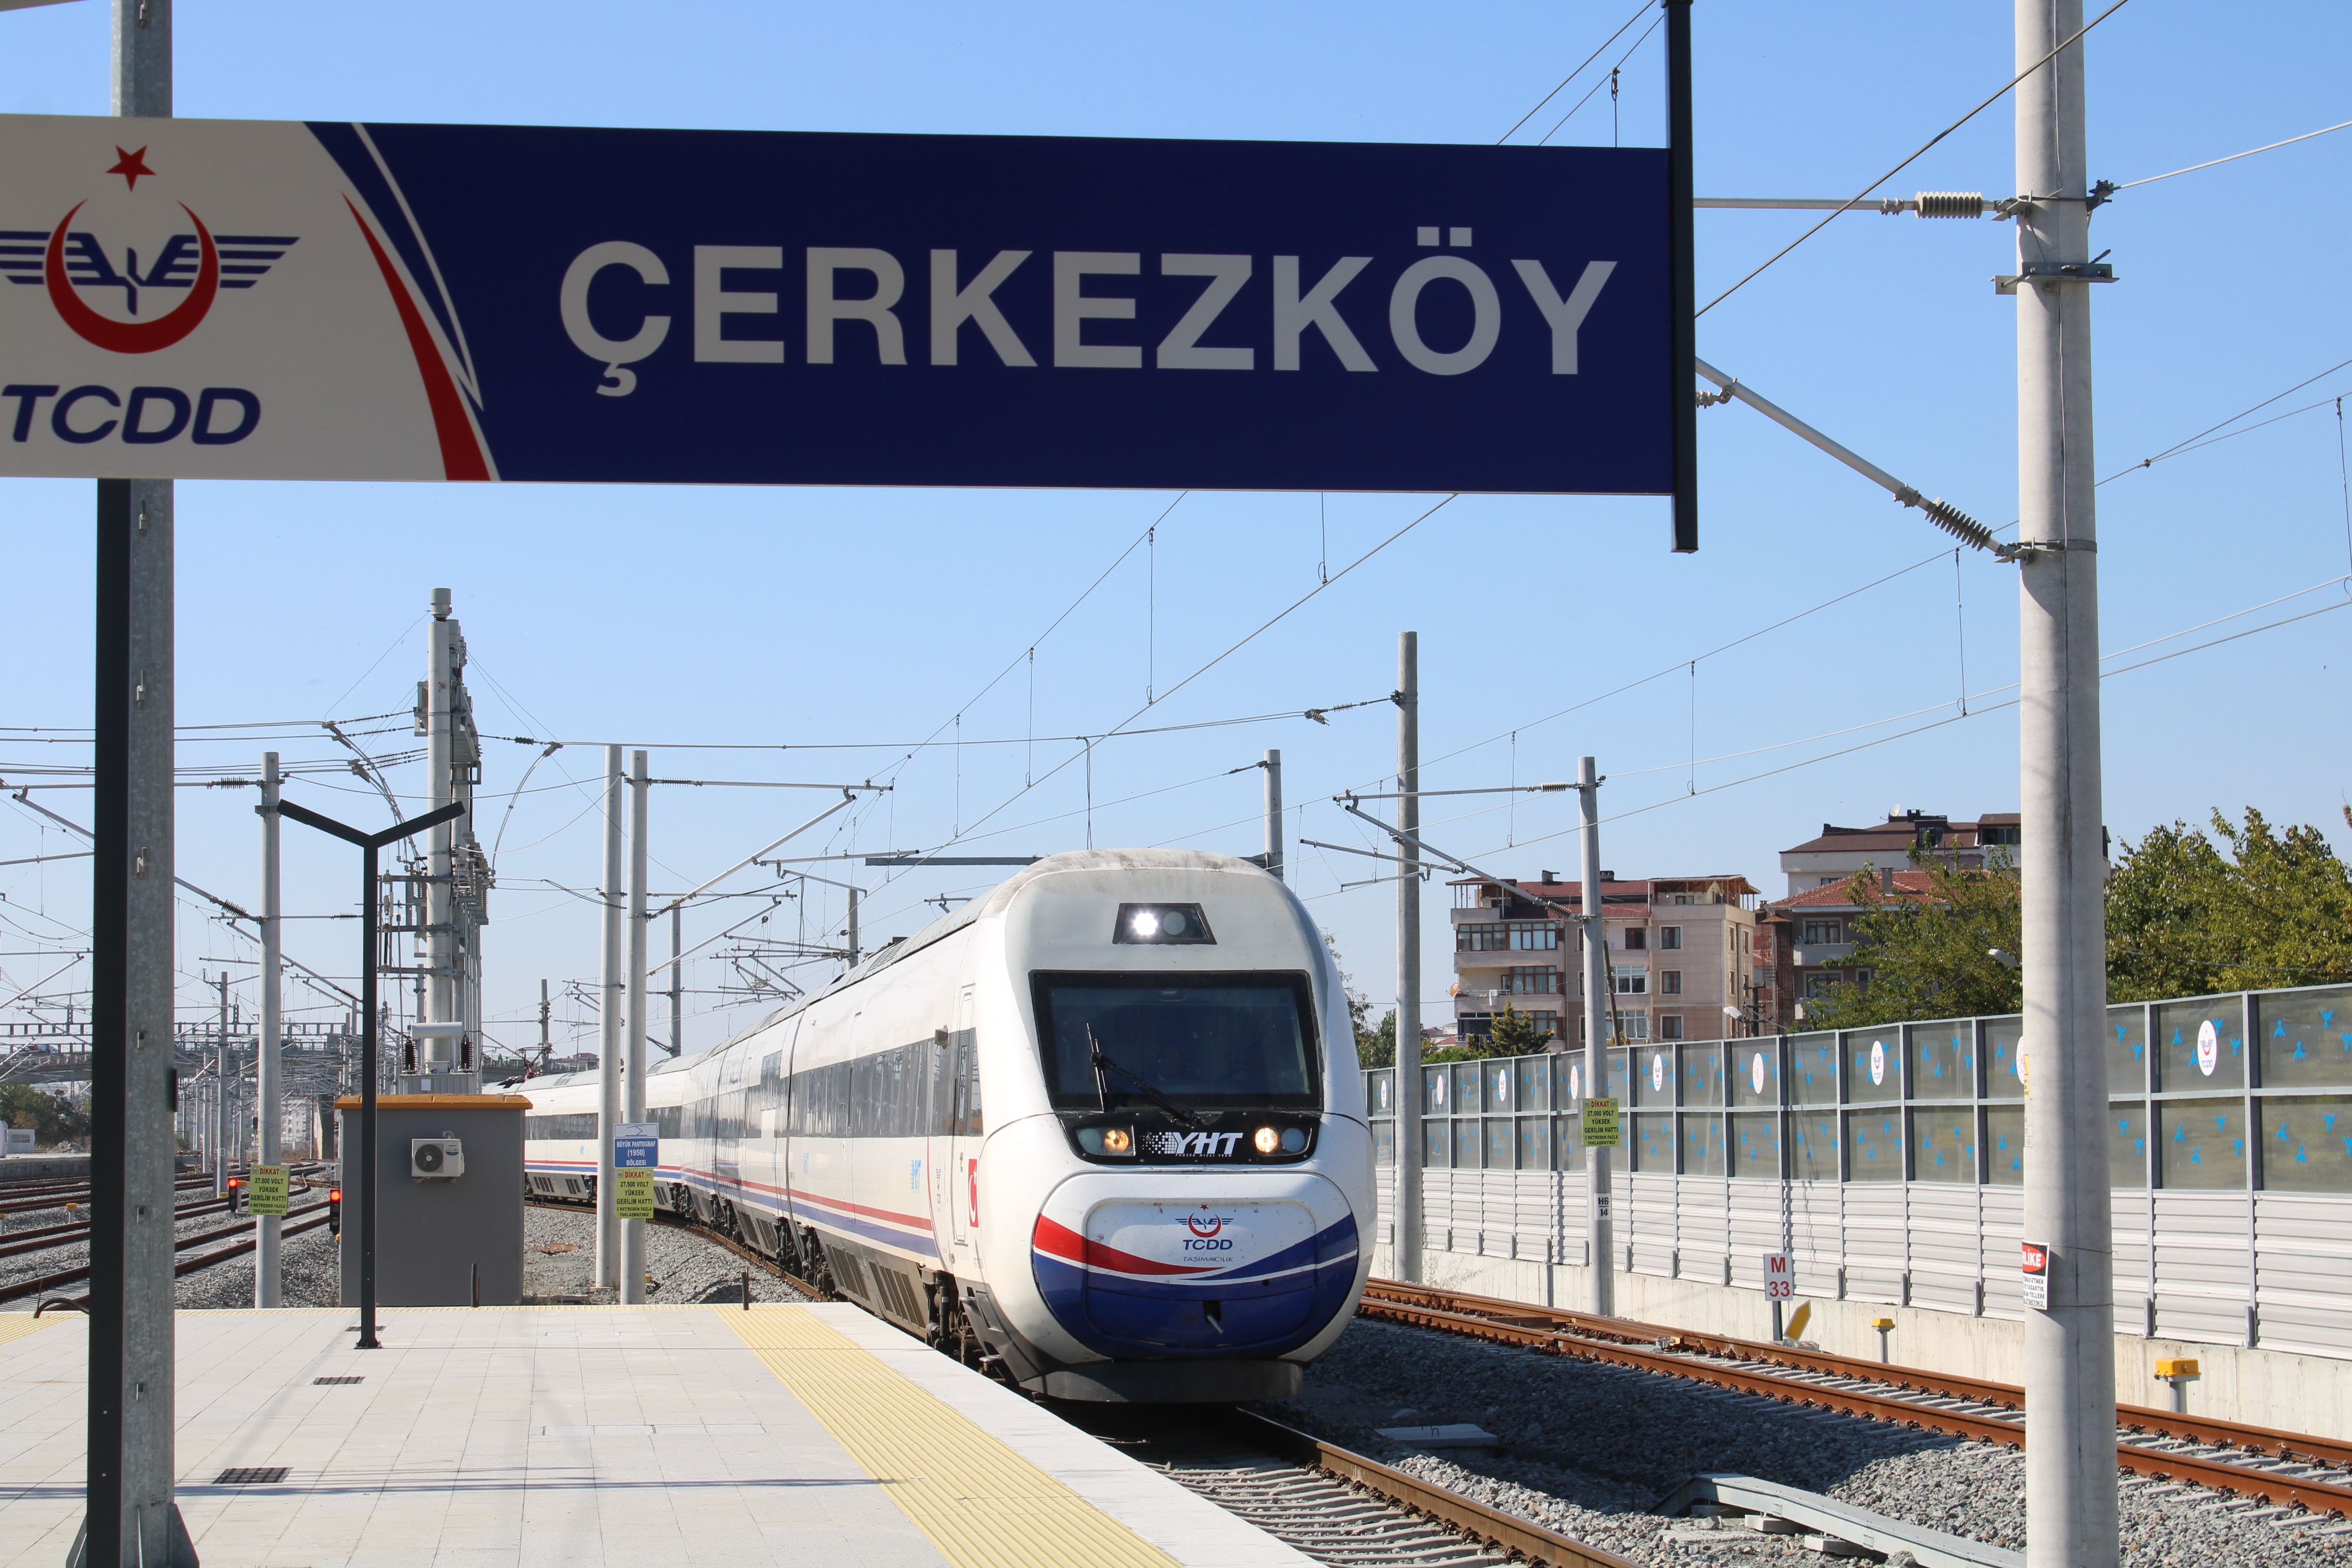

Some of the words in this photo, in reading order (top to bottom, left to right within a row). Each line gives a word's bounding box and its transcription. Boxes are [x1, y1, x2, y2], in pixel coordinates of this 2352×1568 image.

[559, 226, 1618, 397] ÇERKEZKÖY
[1, 384, 262, 445] TCDD
[1172, 1132, 1243, 1154] YHT
[628, 1149, 645, 1157] (1950)
[260, 1167, 280, 1175] DİKKAT
[625, 1170, 645, 1178] DİKKAT
[1598, 1197, 1609, 1205] H6
[1182, 1239, 1233, 1250] TCDD
[1770, 1257, 1786, 1273] M
[1769, 1280, 1791, 1297] 33
